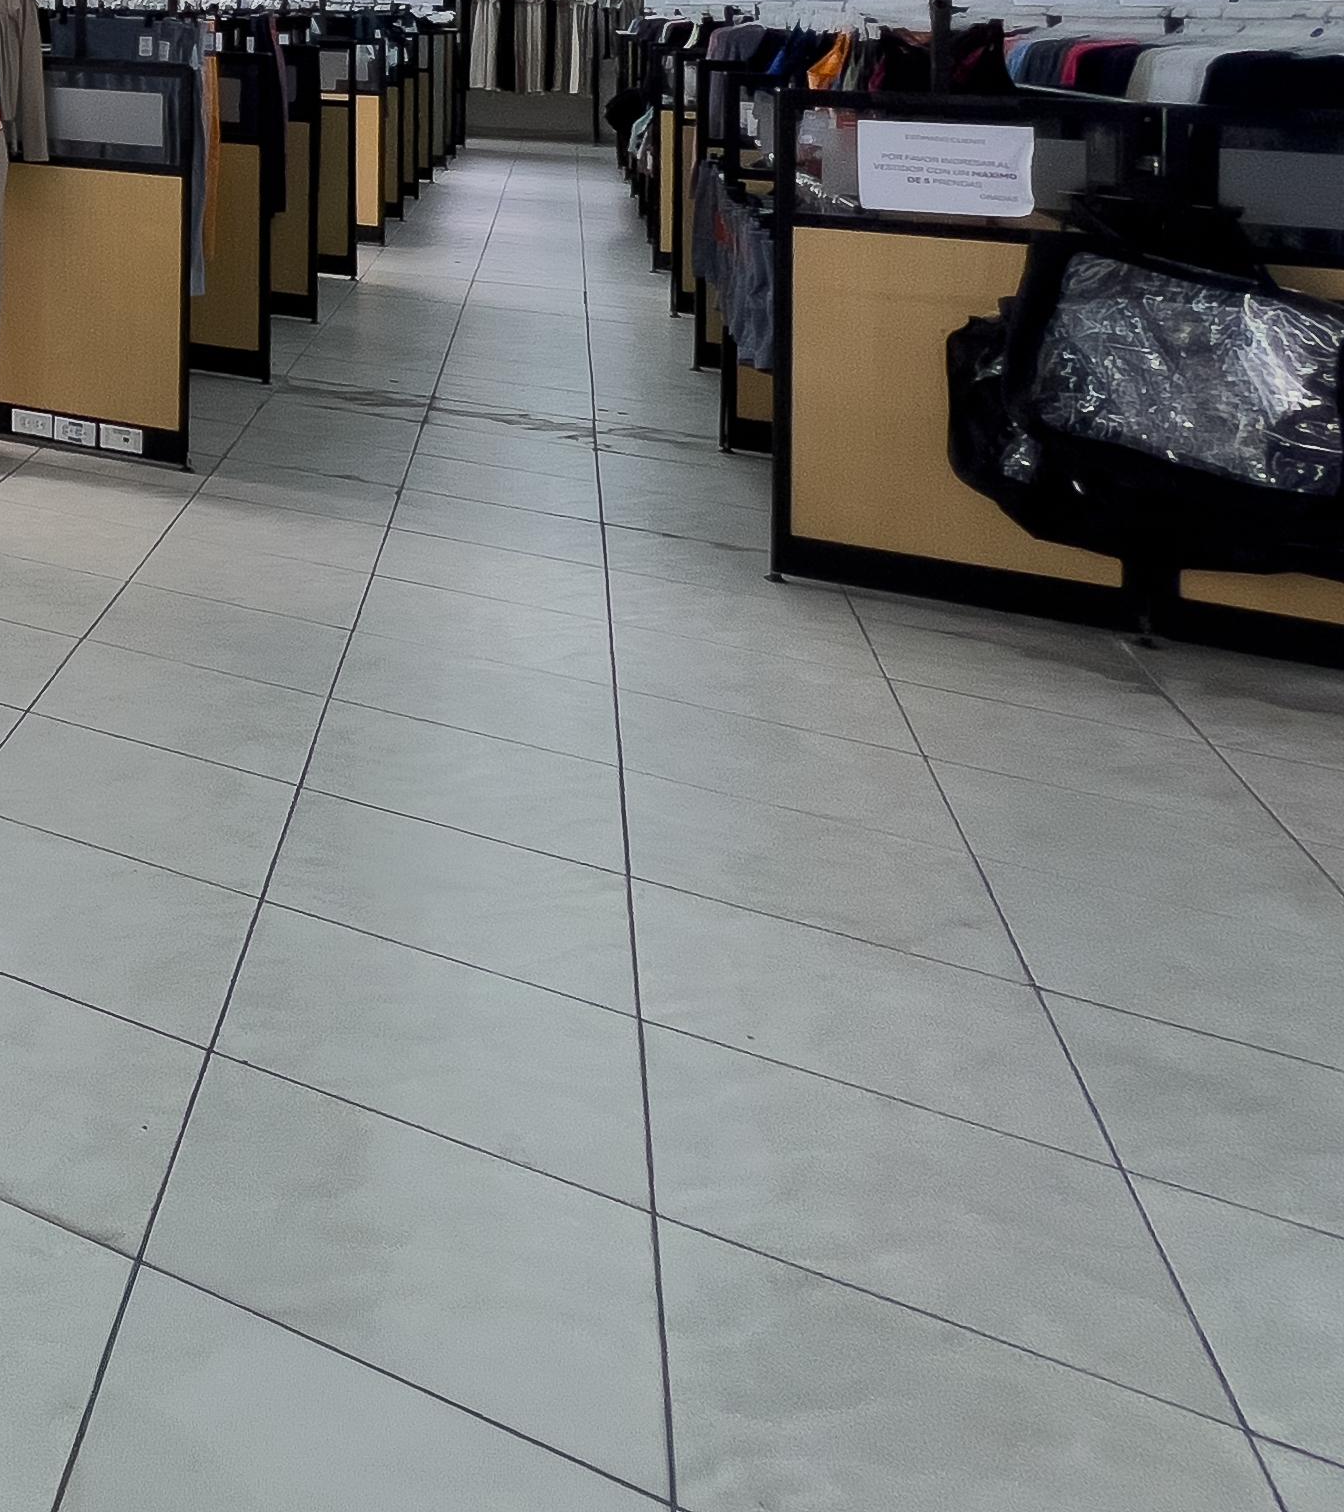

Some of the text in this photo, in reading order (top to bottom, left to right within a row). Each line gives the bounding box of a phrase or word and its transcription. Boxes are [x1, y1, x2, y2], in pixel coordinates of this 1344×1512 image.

[881, 152, 1010, 170] POR FAVOR INGRESAR AL
[873, 163, 923, 173] VESTIDOR
[926, 166, 950, 175] CON
[953, 169, 970, 177] UN
[907, 176, 983, 189] DE 5 PRENDAS
